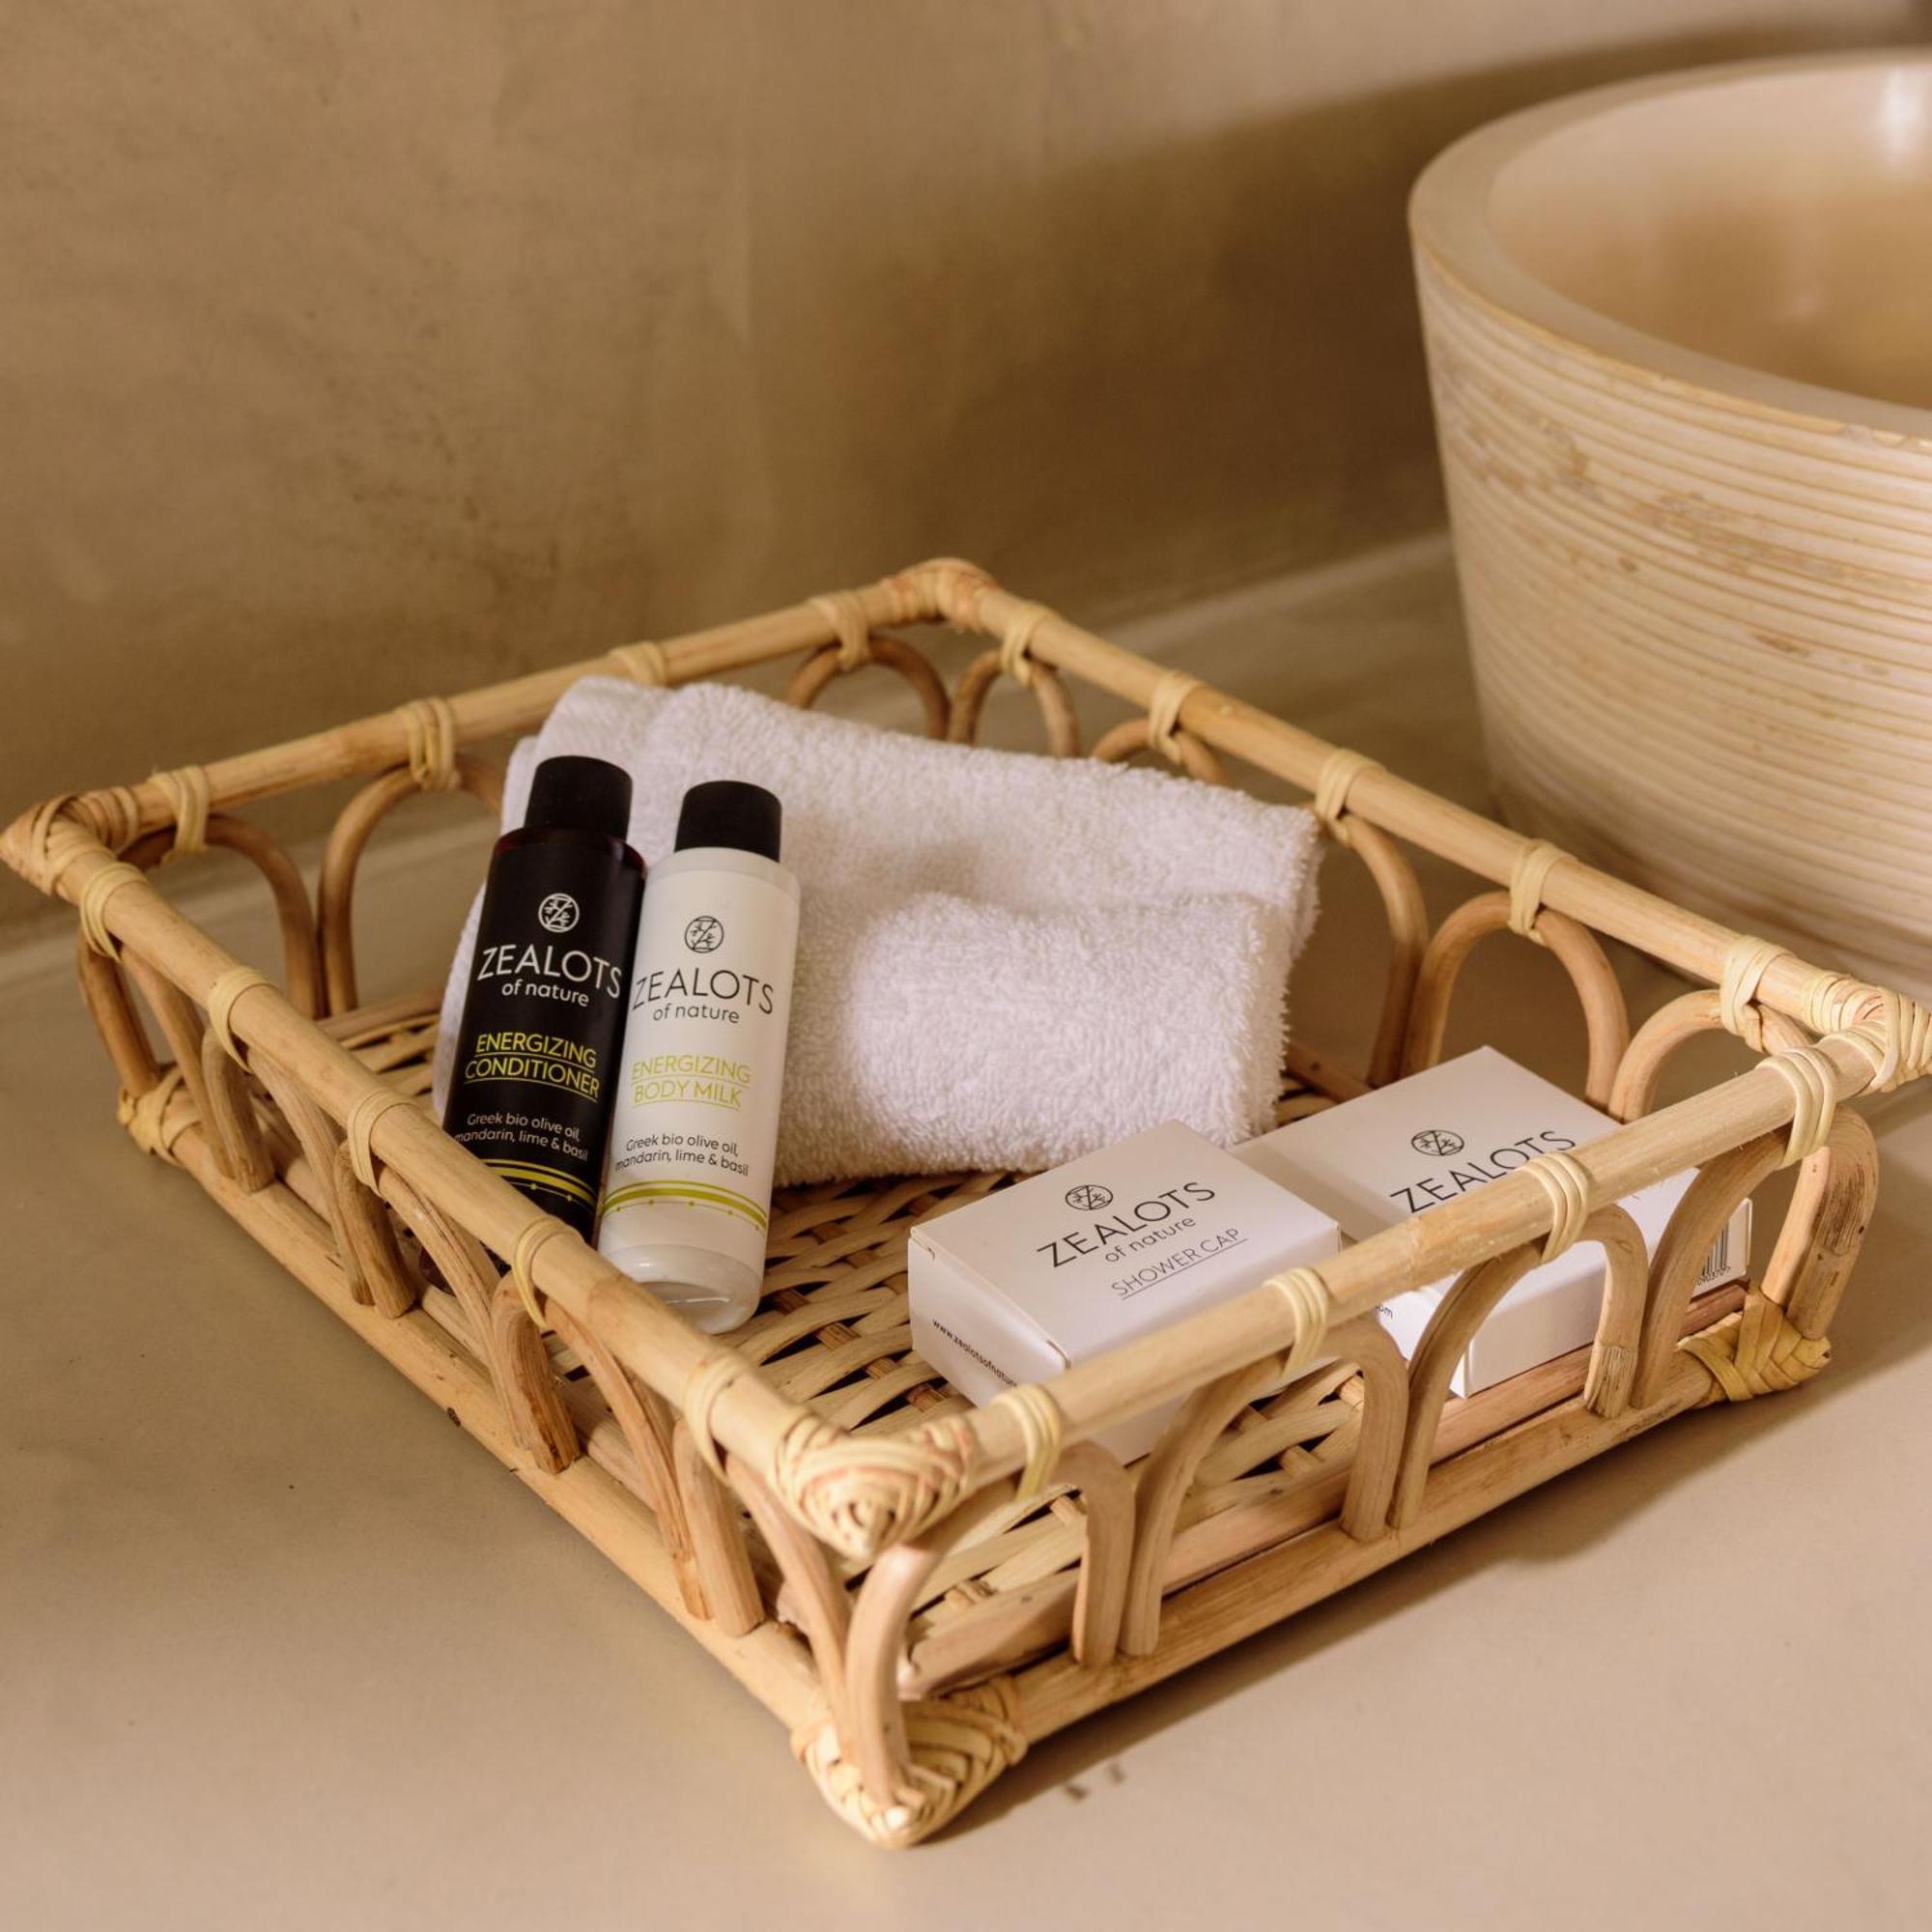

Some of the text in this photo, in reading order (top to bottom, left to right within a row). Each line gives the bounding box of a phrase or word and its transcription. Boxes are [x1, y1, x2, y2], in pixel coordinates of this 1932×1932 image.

[477, 943, 622, 999] ZEALOTS
[501, 978, 590, 1008] of nature
[632, 967, 774, 1015] ZEALOTS
[652, 1002, 740, 1024] of nature
[475, 1032, 597, 1068] ENERGIZING
[465, 1056, 600, 1099] CONDITIONER
[631, 1053, 751, 1085] ENERGIZING
[634, 1078, 743, 1108] BODY MILK
[467, 1112, 502, 1126] Greek
[504, 1112, 528, 1127] bio
[530, 1116, 562, 1134] olive
[519, 1129, 549, 1148] lime
[551, 1137, 560, 1151] &
[562, 1140, 588, 1162] basil
[625, 1133, 658, 1151] Greek
[662, 1132, 683, 1146] bio
[687, 1134, 720, 1151] olive
[675, 1149, 705, 1164] lime
[708, 1152, 717, 1166] &
[721, 1154, 749, 1177] basil
[1388, 1129, 1577, 1214] ZEALOTS
[1036, 1180, 1216, 1269] ZEALOTS
[1104, 1215, 1197, 1264] of nature
[1111, 1227, 1240, 1296] SHOWER CAP
